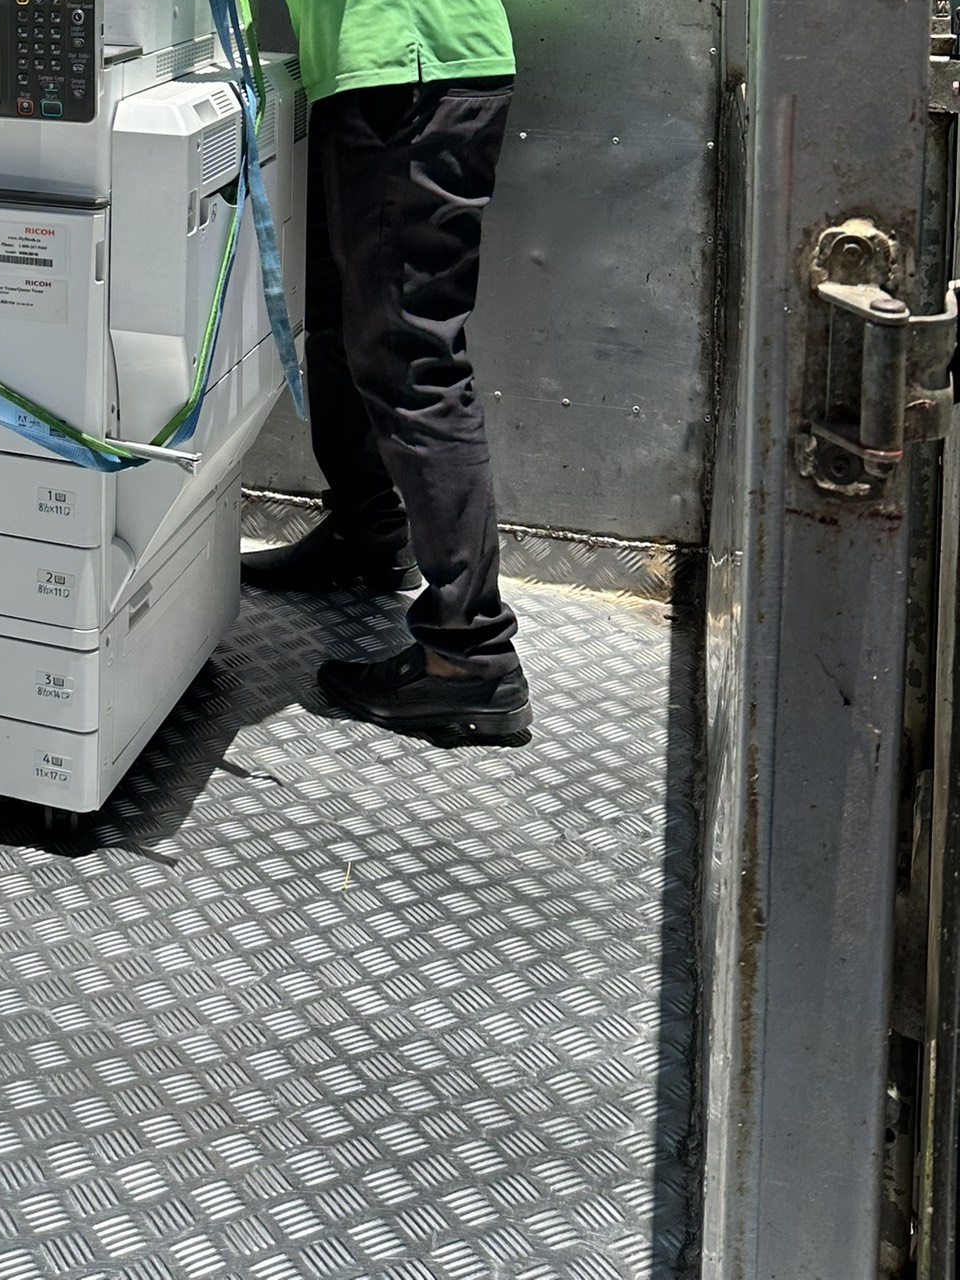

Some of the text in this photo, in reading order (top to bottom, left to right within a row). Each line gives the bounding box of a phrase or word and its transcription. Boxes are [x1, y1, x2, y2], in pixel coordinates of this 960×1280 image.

[25, 227, 55, 236] RICOH
[46, 572, 53, 583] 2
[45, 674, 51, 685] 3
[43, 753, 50, 764] 4
